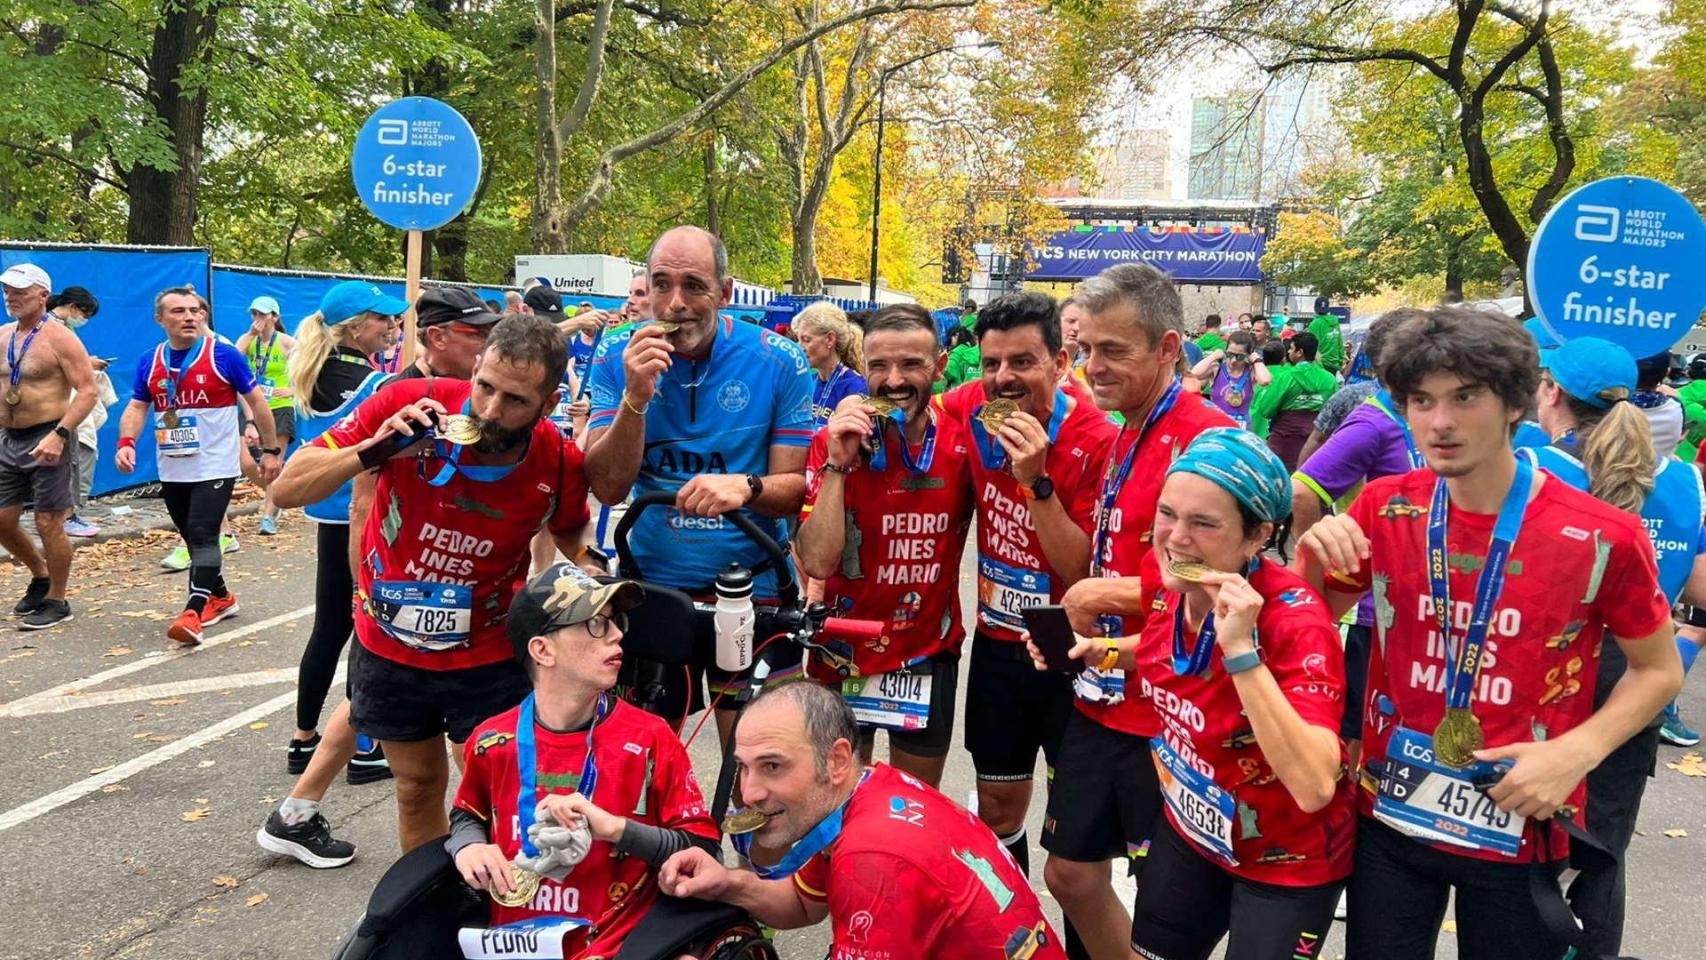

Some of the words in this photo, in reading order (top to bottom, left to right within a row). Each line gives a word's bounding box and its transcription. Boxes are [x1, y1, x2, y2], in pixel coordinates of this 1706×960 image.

[411, 133, 456, 142] MARATHON
[383, 154, 447, 178] 6-star
[373, 181, 454, 206] finisher
[1625, 218, 1663, 229] WORLD
[1626, 209, 1667, 221] ABBOTT
[1622, 237, 1667, 248] MAJORS
[1623, 227, 1685, 241] MARATHON
[1032, 246, 1064, 260] TCS
[1068, 249, 1101, 260] NEW
[1103, 249, 1140, 261] YORK
[1142, 250, 1174, 261] CITY
[1177, 251, 1256, 262] MARATHON
[554, 277, 595, 288] United
[1579, 255, 1671, 290] 6-star
[1563, 291, 1678, 329] finisher
[595, 330, 632, 358] deso
[766, 333, 808, 376] desol
[170, 429, 195, 443] 40305
[671, 514, 724, 530] desol
[882, 512, 949, 536] PEDRO
[418, 523, 494, 558] PEDRO
[888, 538, 936, 560] INES
[419, 547, 475, 577] INES
[876, 562, 941, 586] MARIO
[1433, 548, 1444, 580] 2022
[415, 608, 457, 633] 7825
[1417, 594, 1522, 638] PDO
[1463, 643, 1480, 674] 2022
[879, 672, 922, 702] 43014
[1409, 661, 1513, 706] MAIO
[1141, 677, 1206, 733] PEDRO
[1403, 739, 1433, 763] tcs
[1398, 767, 1410, 779] 4
[1393, 784, 1407, 797] D
[1178, 788, 1227, 841] 46538
[1435, 819, 1469, 836] 2022
